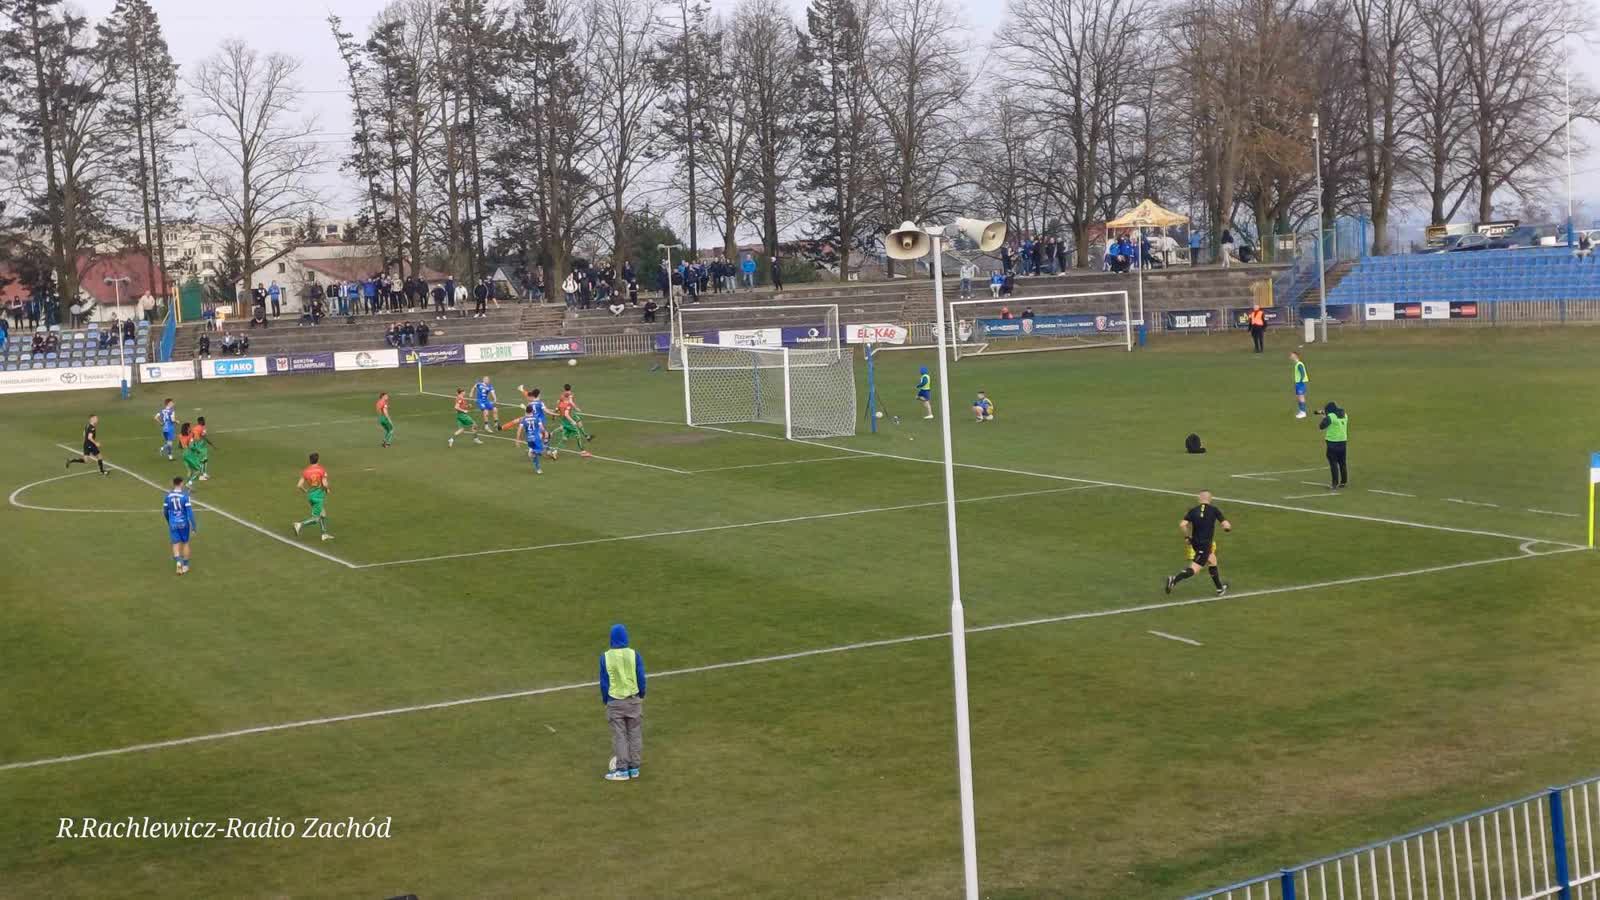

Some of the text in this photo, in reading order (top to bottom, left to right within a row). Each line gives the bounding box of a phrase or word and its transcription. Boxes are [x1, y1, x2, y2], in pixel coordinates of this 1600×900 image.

[540, 343, 570, 352] ANMAR
[228, 363, 252, 372] JAKO
[171, 497, 181, 510] 11
